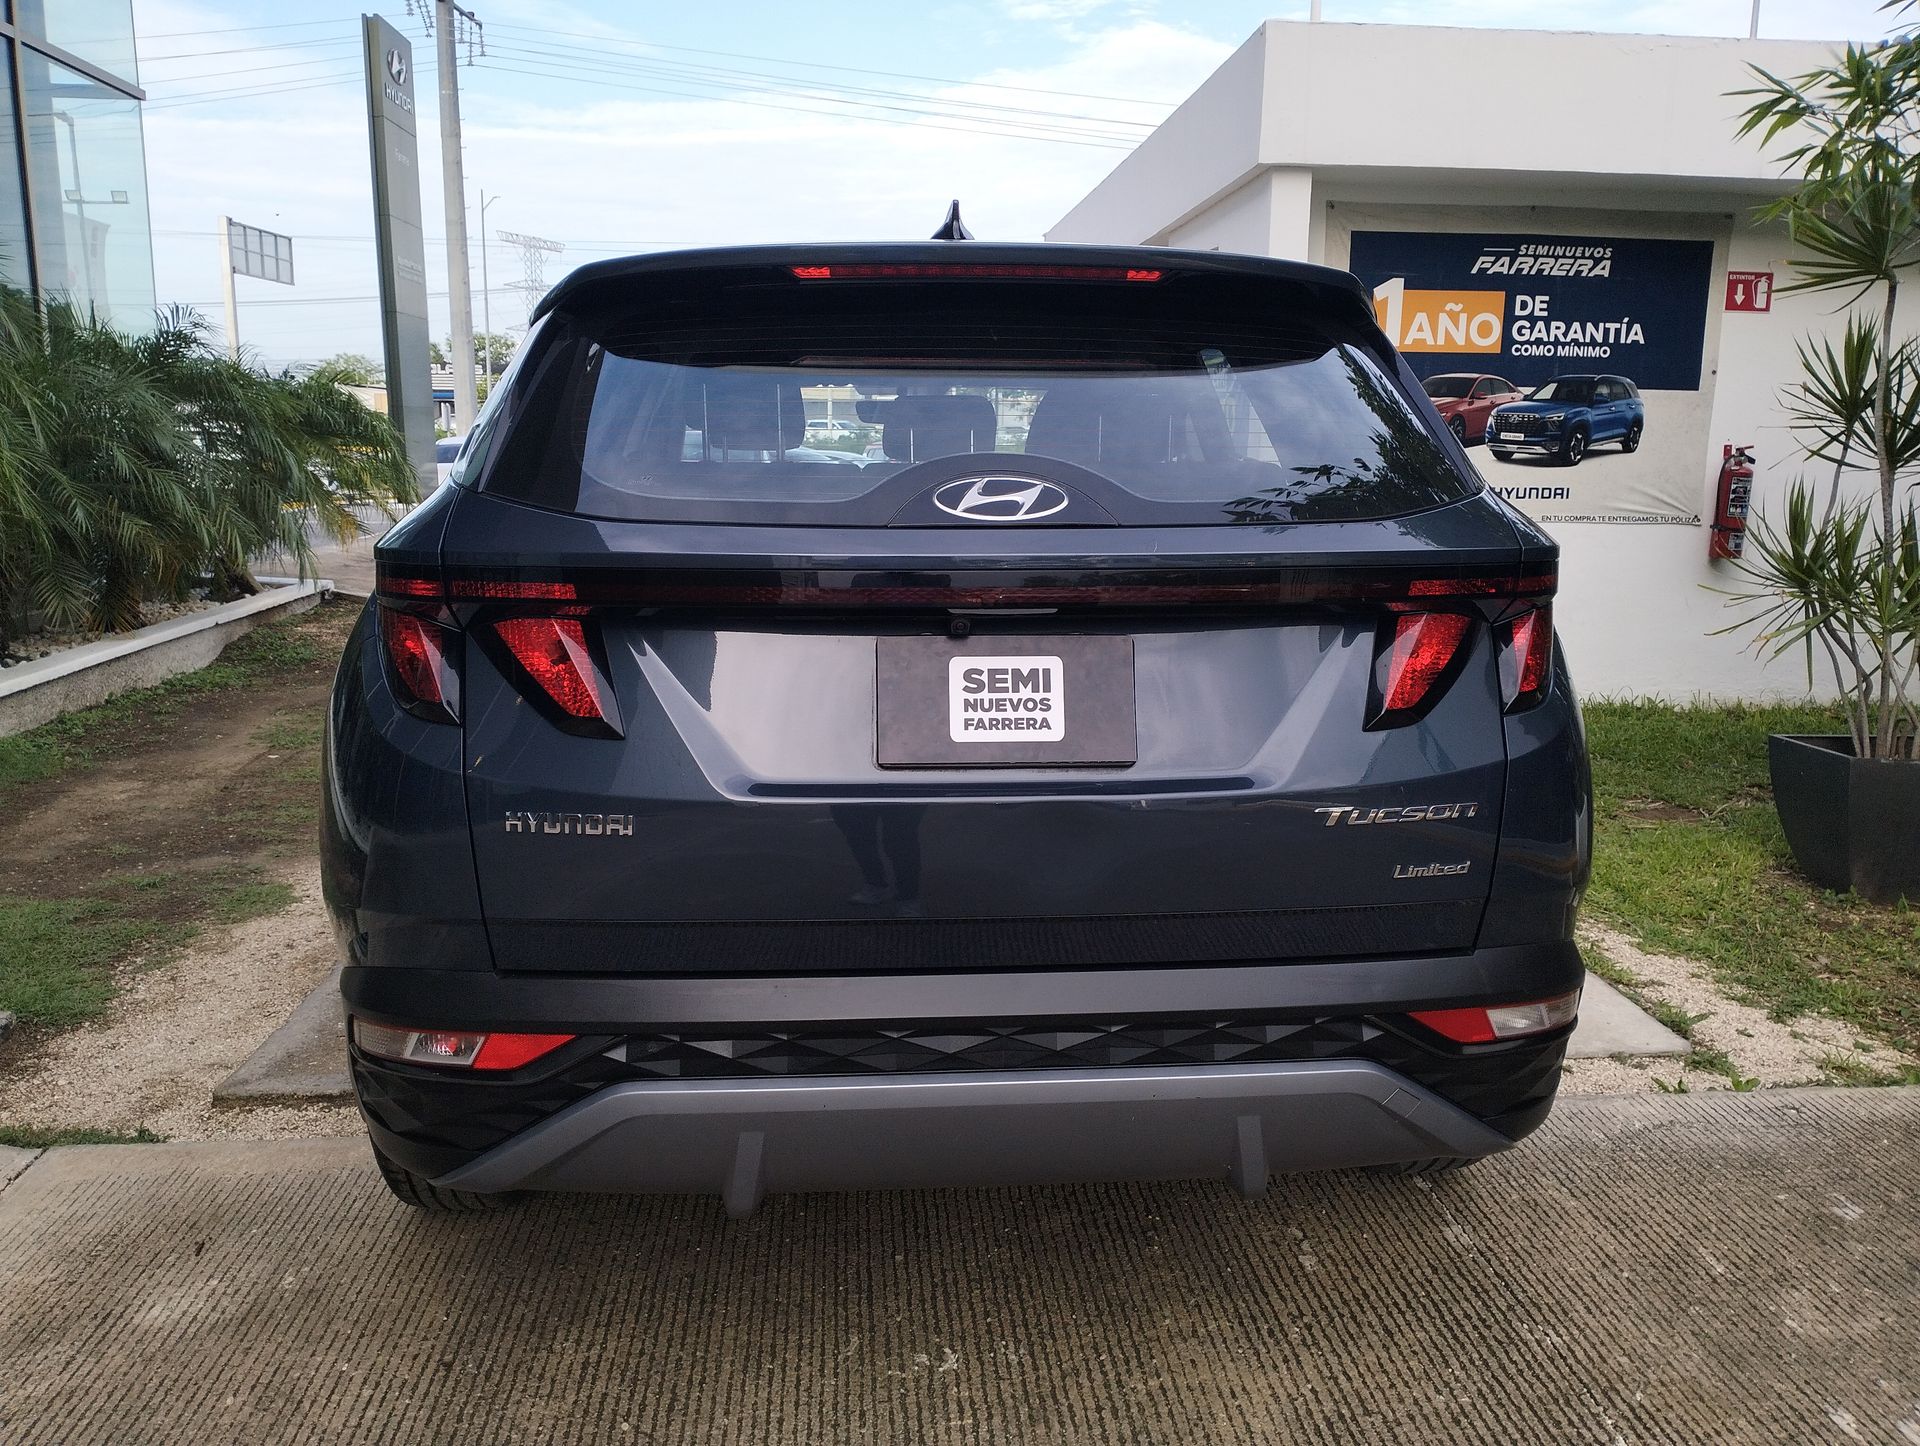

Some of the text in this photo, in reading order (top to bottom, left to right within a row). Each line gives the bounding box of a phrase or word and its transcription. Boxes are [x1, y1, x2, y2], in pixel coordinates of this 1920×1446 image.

[1518, 245, 1613, 258] SEMINUEVOS
[1470, 256, 1612, 277] FARRERA
[1373, 277, 1501, 347] 1 AÑO
[1514, 294, 1550, 317] DE
[1511, 317, 1645, 344] GARANTÍA
[1511, 342, 1611, 358] COMO MÍNIMO
[1607, 515, 1659, 523] ENTREGAMOS
[962, 668, 1052, 694] SEMI
[963, 697, 1052, 713] NUEVOS
[963, 717, 1052, 731] FARRERA
[505, 811, 634, 836] HYUNDAI
[1393, 860, 1471, 879] Limited
